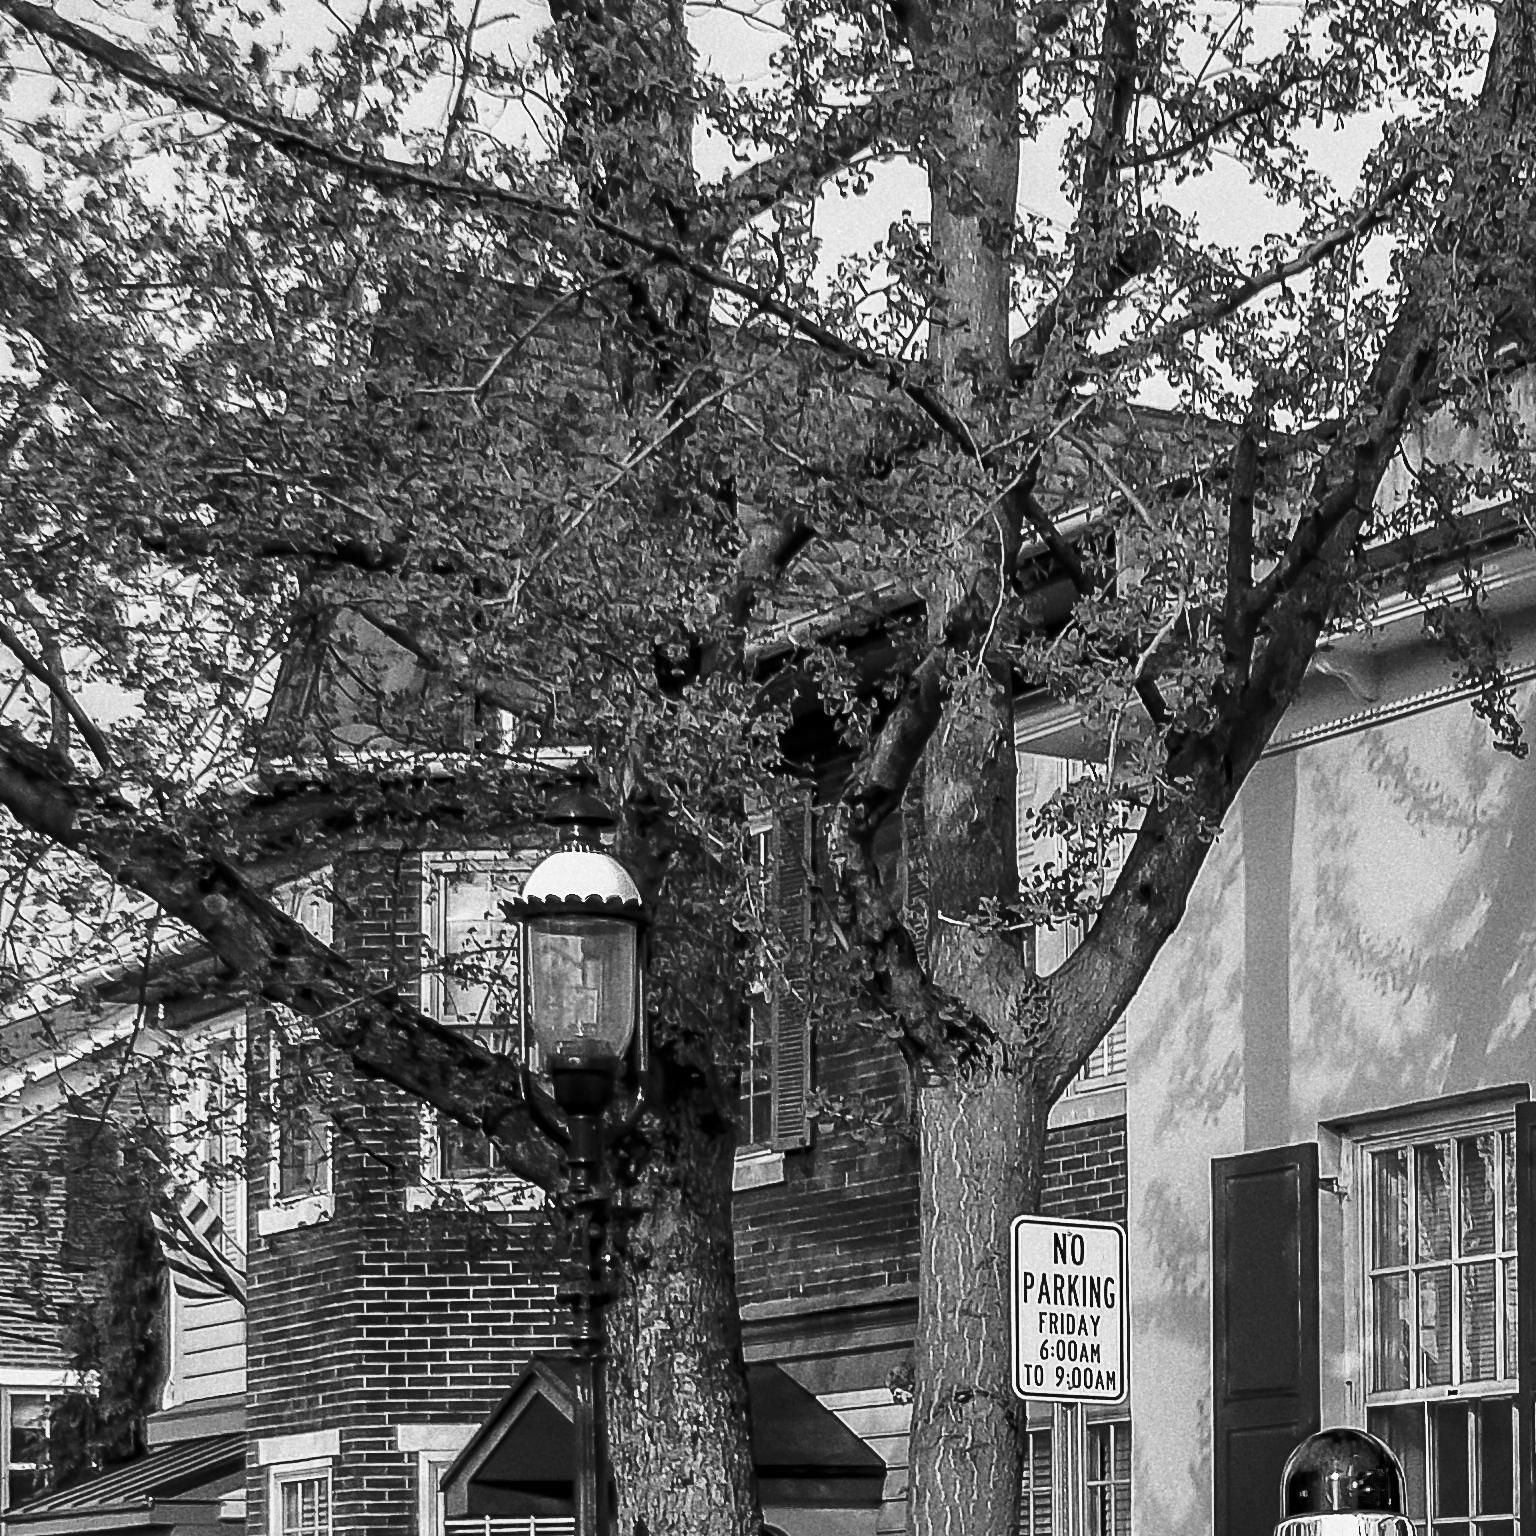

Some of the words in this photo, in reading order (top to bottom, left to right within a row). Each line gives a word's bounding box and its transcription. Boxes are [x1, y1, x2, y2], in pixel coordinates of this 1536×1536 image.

[1053, 1232, 1085, 1266] NO
[1023, 1271, 1116, 1309] PARKING
[1038, 1311, 1101, 1337] FRIDAY
[1039, 1339, 1101, 1364] 6:00AM
[1023, 1363, 1044, 1387] TO
[1055, 1365, 1116, 1391] 9:00AM
